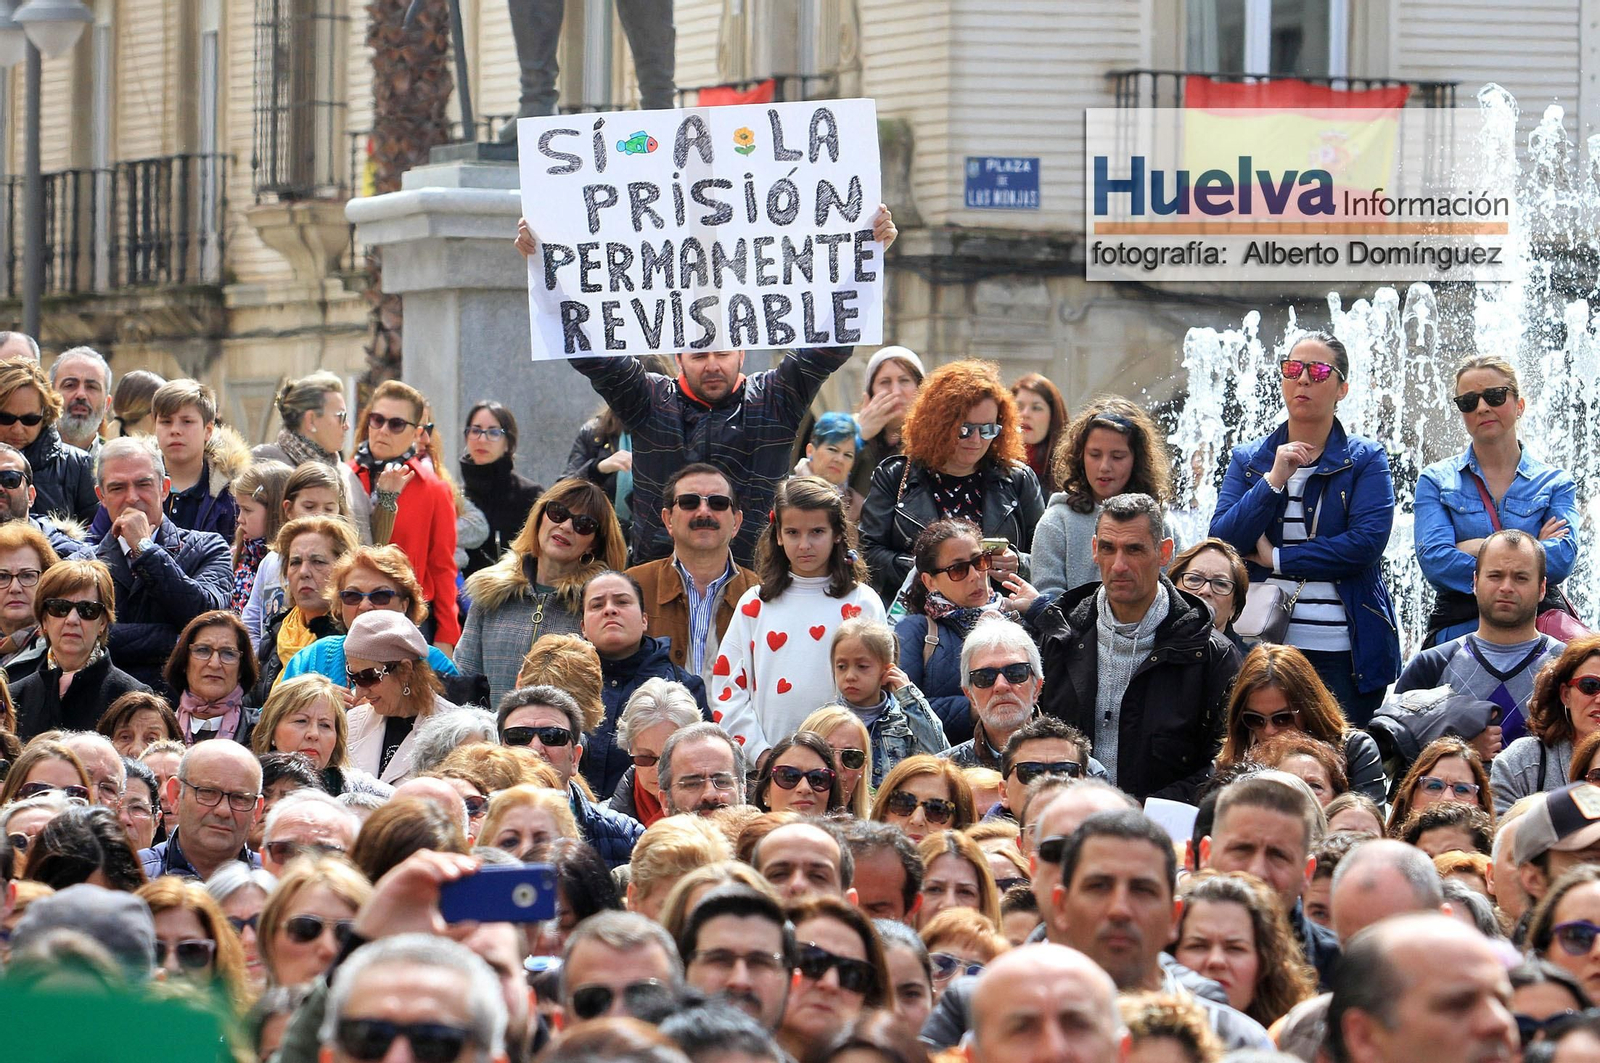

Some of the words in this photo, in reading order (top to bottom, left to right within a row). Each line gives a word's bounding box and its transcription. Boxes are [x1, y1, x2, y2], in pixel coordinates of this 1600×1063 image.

[673, 114, 715, 170] A
[767, 107, 840, 164] LA
[986, 158, 1032, 173] PLAZA
[541, 229, 877, 294] PERMANENTE
